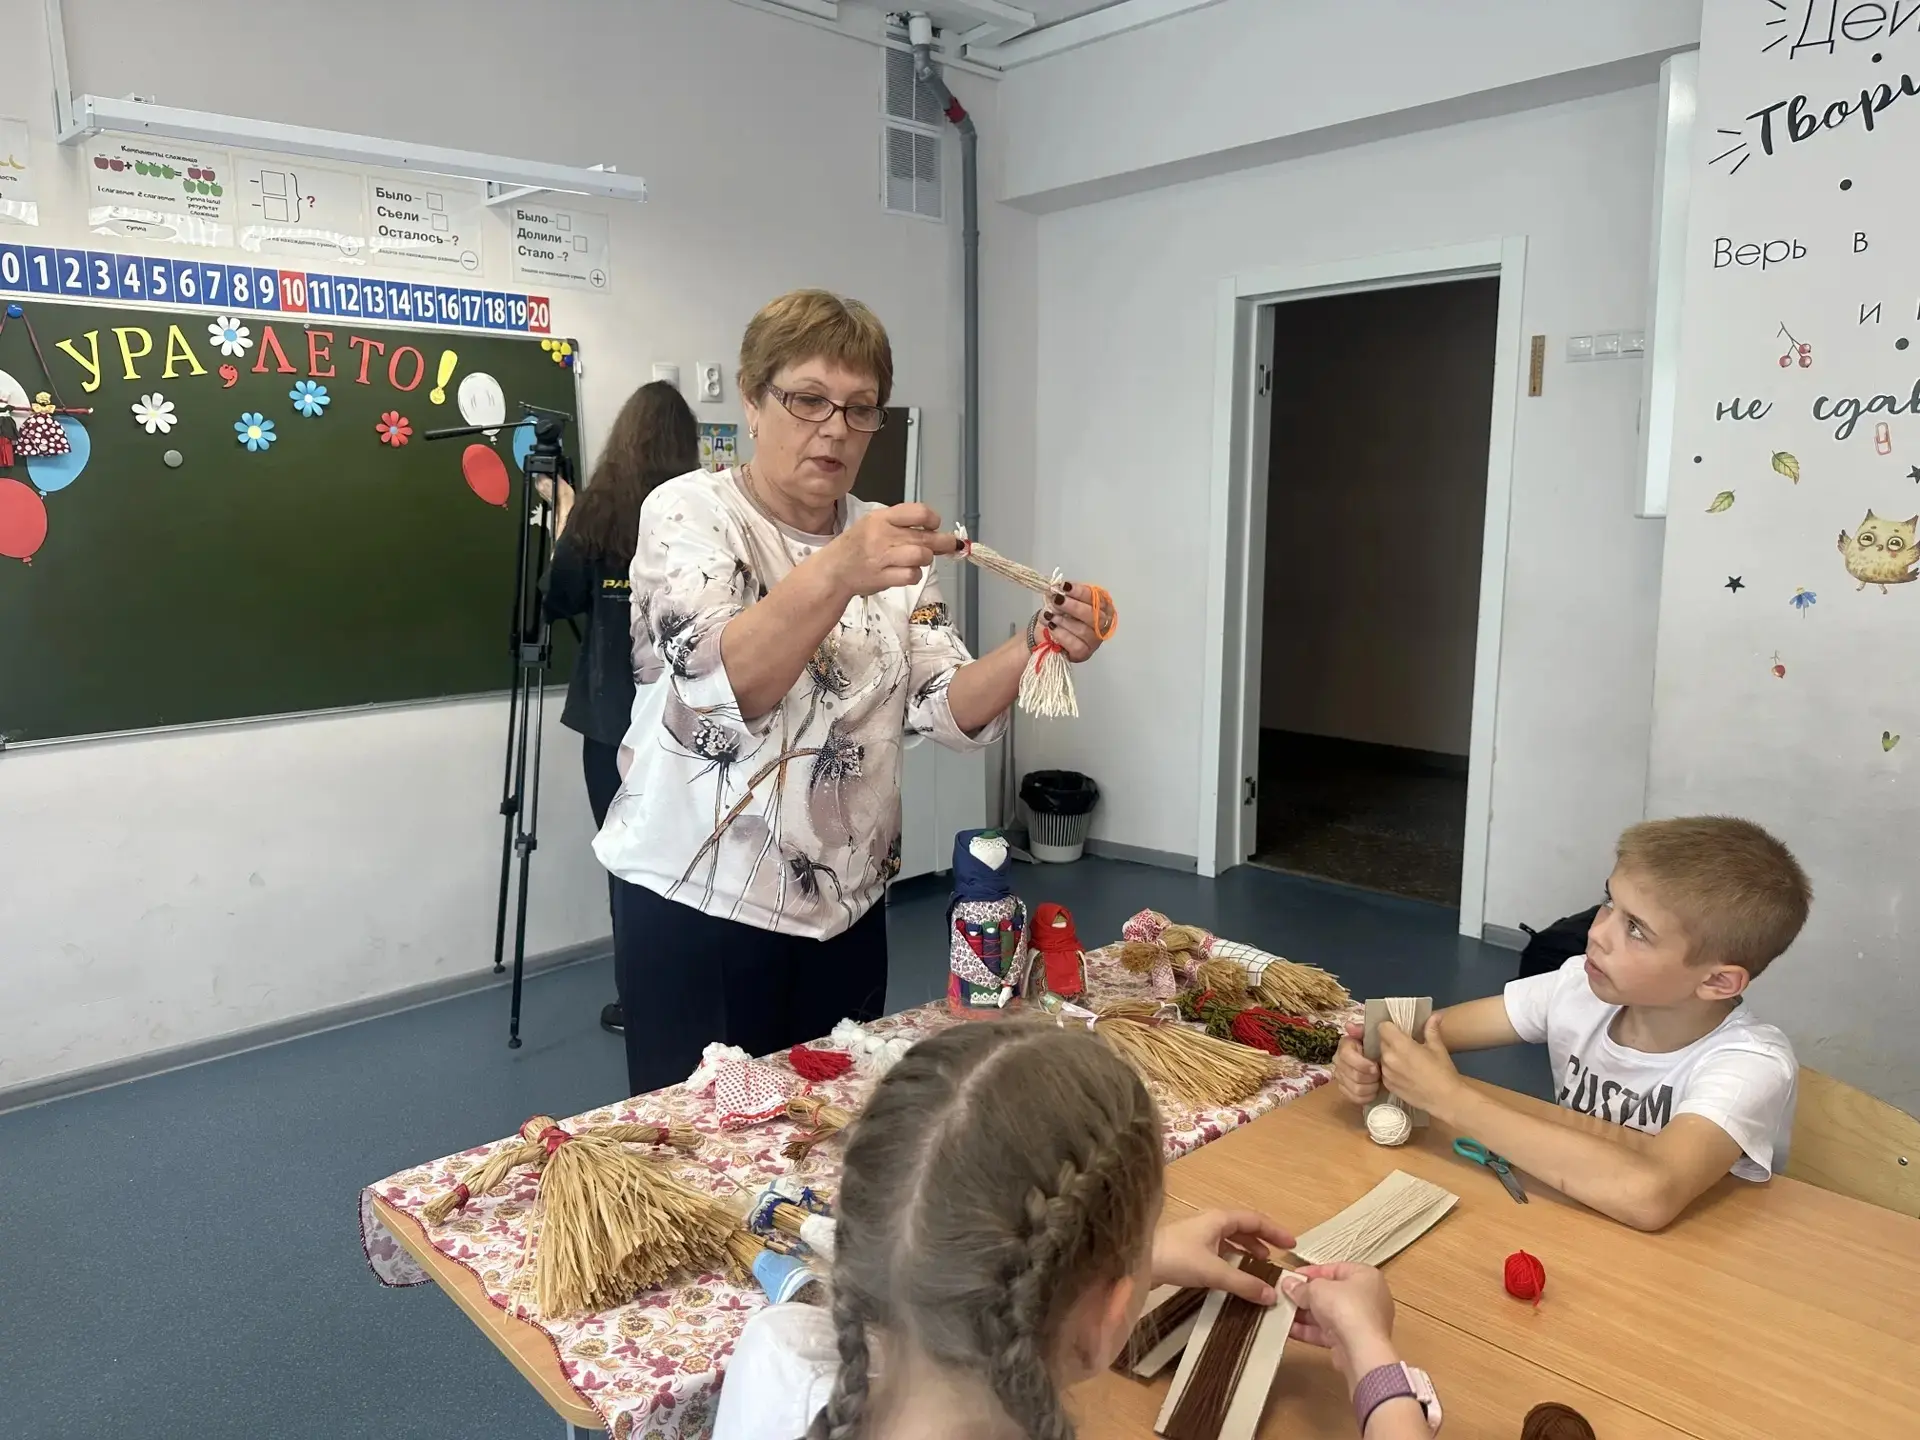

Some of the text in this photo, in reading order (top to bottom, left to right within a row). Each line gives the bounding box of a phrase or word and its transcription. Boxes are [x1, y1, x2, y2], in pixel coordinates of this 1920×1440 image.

[375, 187, 412, 202] Было
[377, 206, 419, 221] Съели
[517, 209, 548, 224] Было
[378, 225, 443, 244] Осталось
[516, 227, 562, 243] Долили
[518, 245, 555, 260] Стало
[1713, 237, 1807, 271] Верь
[1, 251, 549, 328] 0 1 2 3 4 5 6 7 8 9 10 11 12 13 14 15 16 17 18 19 20
[251, 325, 459, 405] ЛЕТО!
[1715, 397, 1773, 422] не
